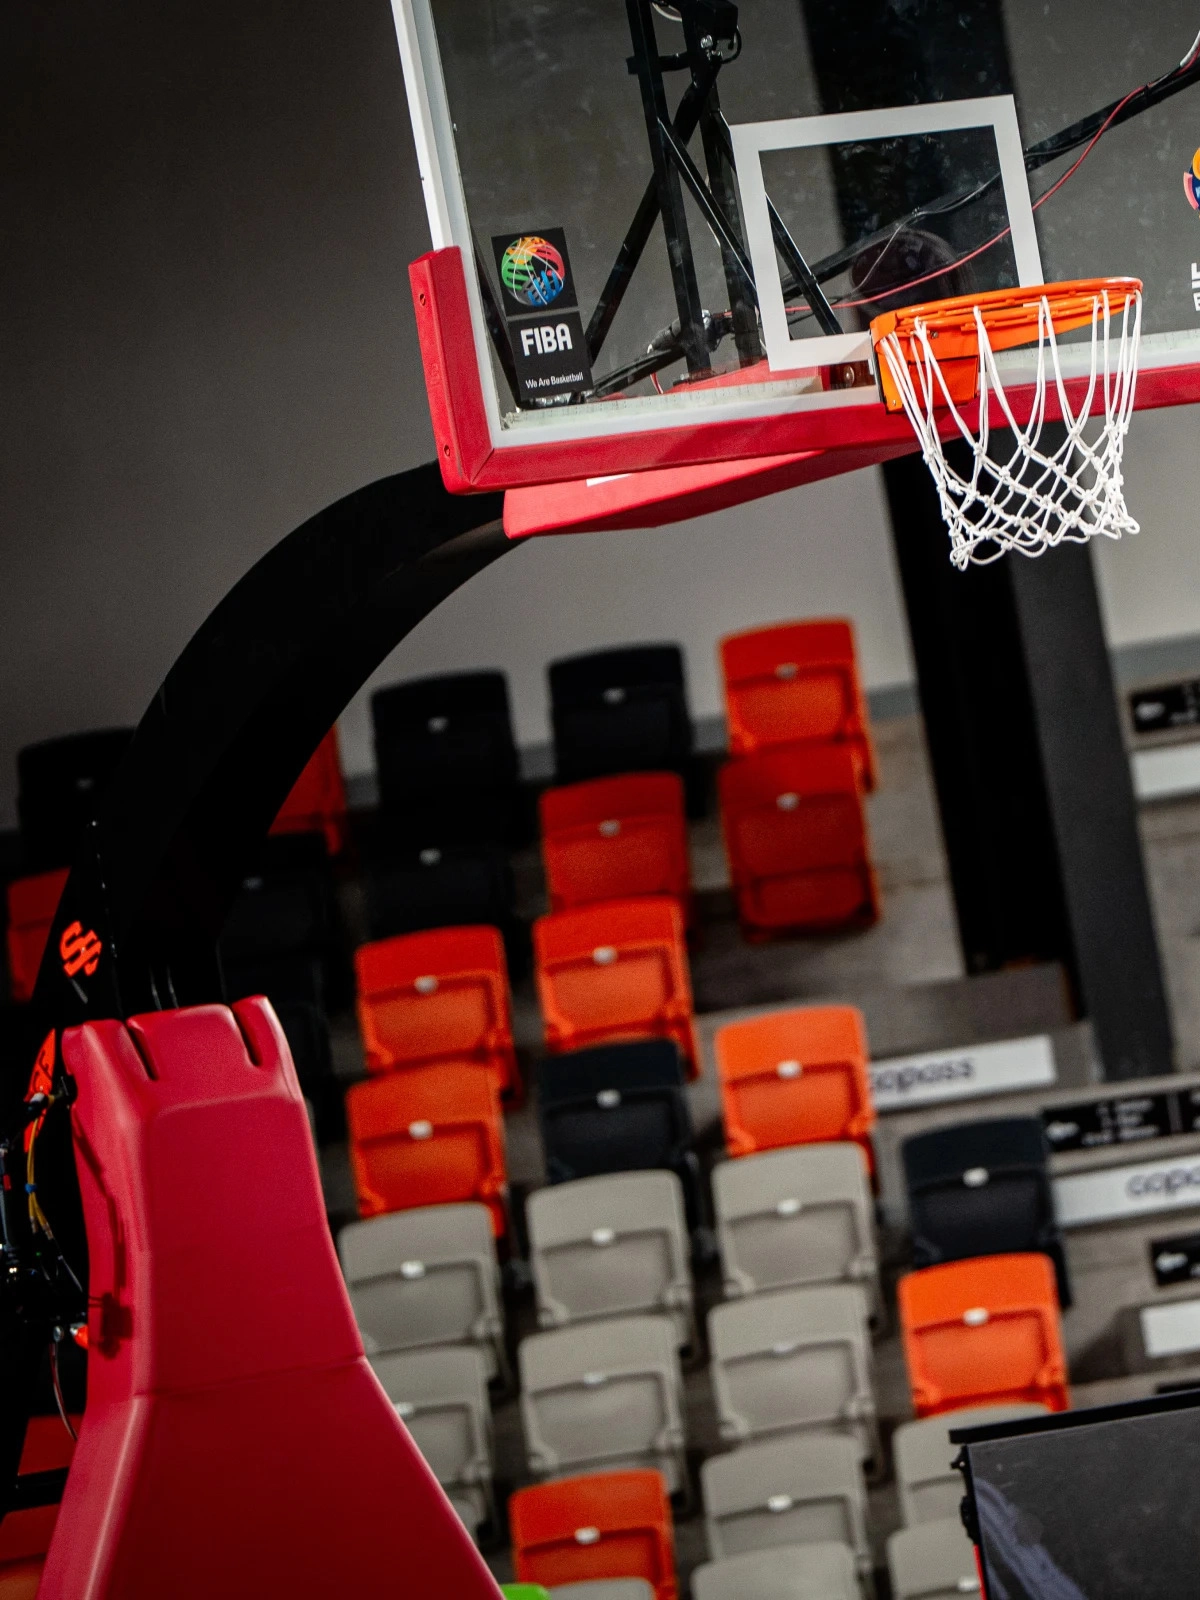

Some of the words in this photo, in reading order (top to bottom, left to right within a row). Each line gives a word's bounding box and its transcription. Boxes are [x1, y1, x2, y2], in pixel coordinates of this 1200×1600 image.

[520, 323, 573, 356] FIBA
[525, 378, 538, 389] We
[538, 376, 550, 387] Are
[550, 372, 584, 385] Basketball
